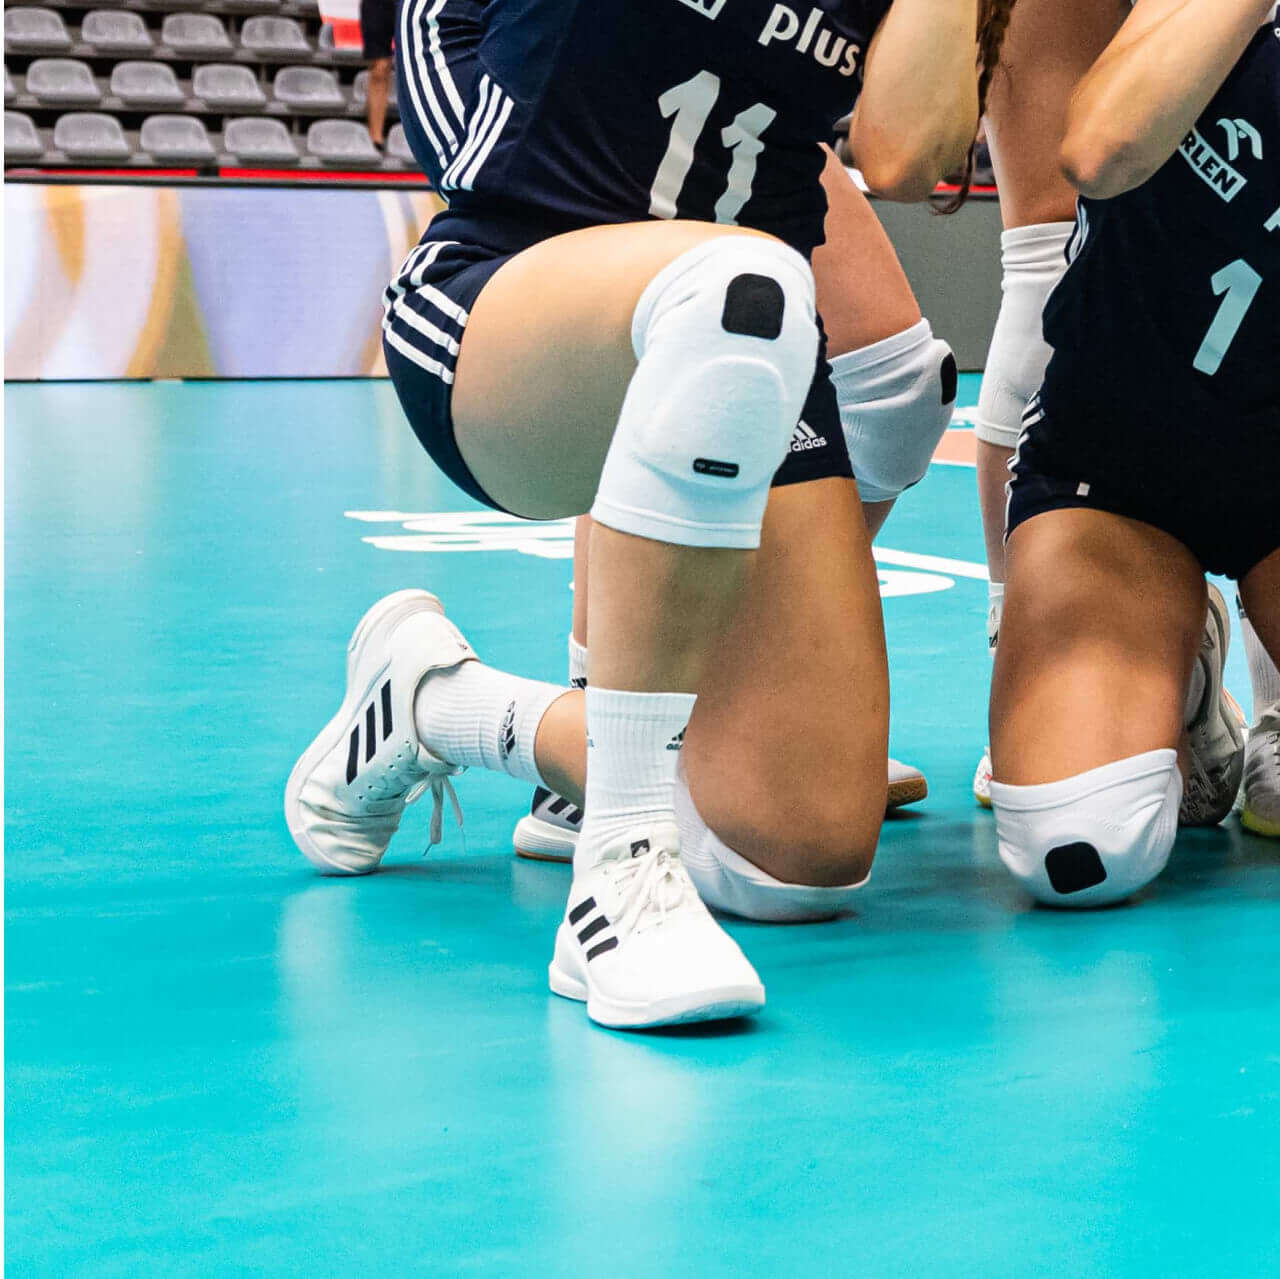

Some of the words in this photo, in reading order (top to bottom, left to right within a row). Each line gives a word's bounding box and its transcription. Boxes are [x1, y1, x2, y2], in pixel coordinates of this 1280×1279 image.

[757, 3, 861, 77] plus
[648, 70, 777, 226] 11
[1181, 130, 1238, 196] RLEN
[1192, 259, 1263, 376] 1
[790, 436, 828, 452] didas
